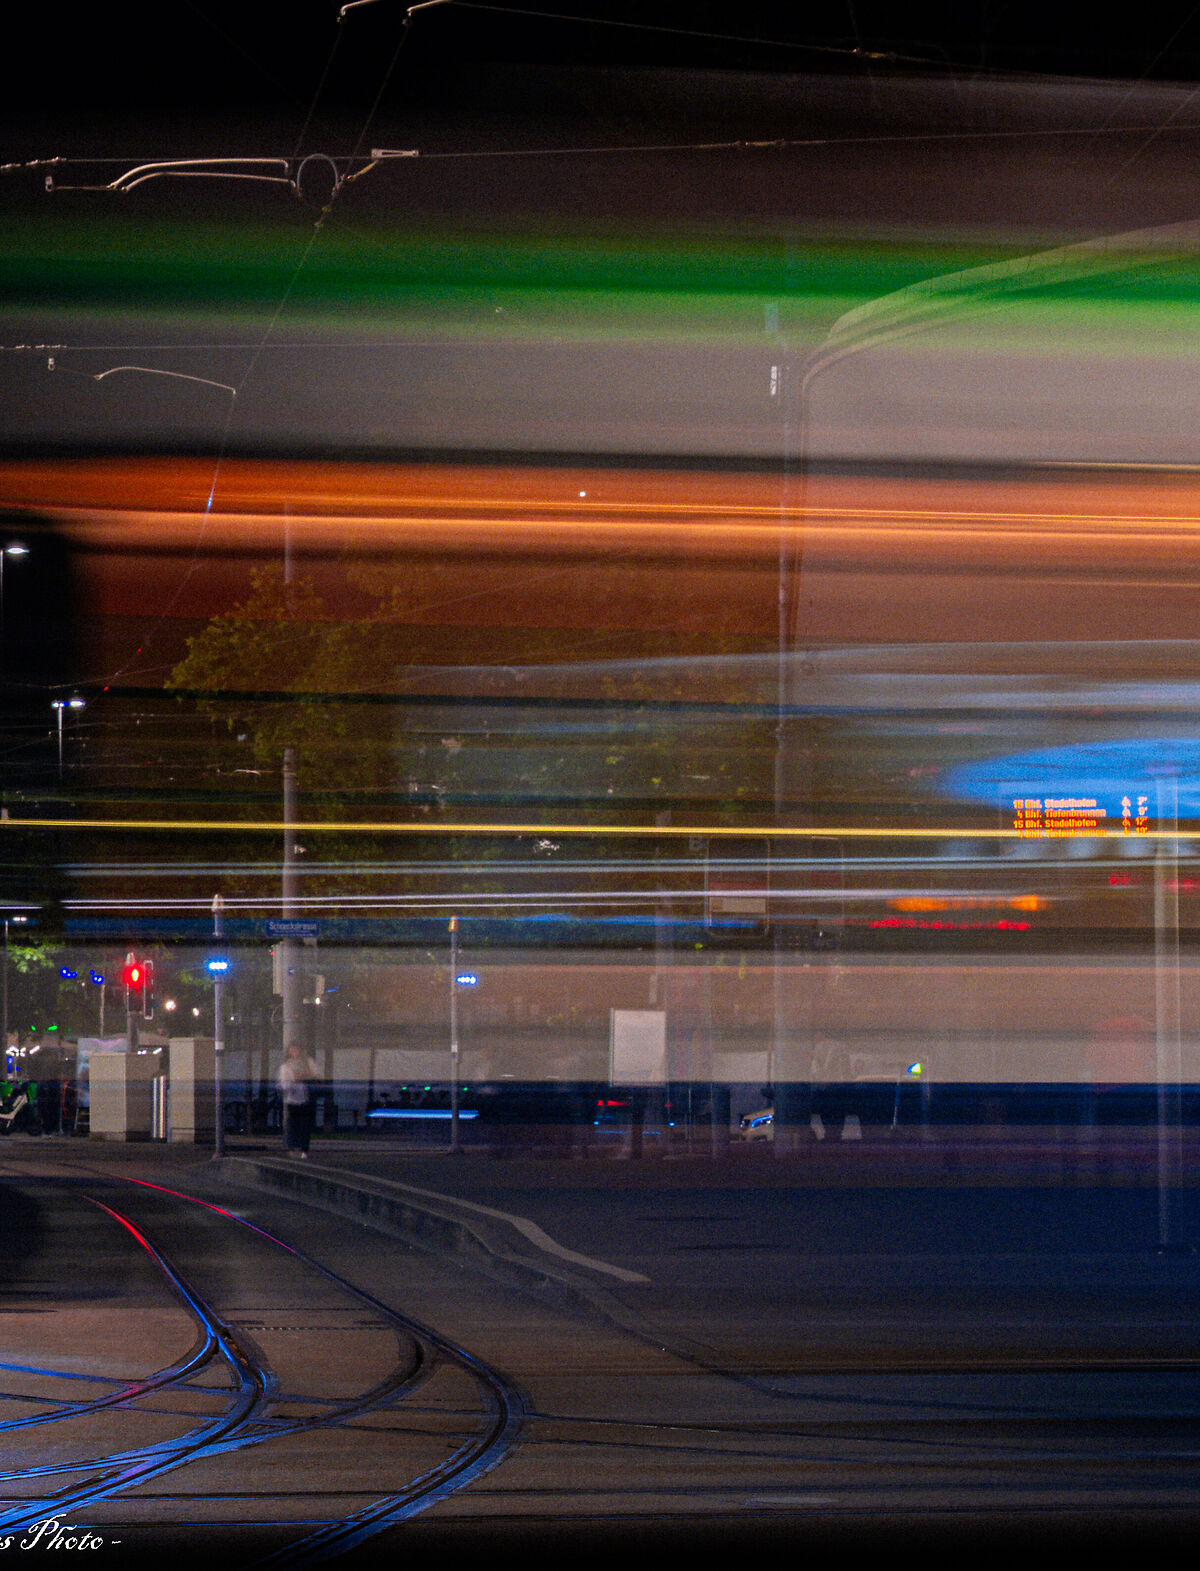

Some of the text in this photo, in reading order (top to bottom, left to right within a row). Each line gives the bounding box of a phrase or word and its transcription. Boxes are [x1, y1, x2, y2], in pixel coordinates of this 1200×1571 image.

[1013, 800, 1024, 809] 15
[1044, 799, 1097, 808] Stadelhofen
[1025, 809, 1042, 818] Bhf.
[1013, 820, 1024, 829] 15
[1025, 819, 1043, 828] Bhf.
[1044, 818, 1097, 828] Stadelhofen
